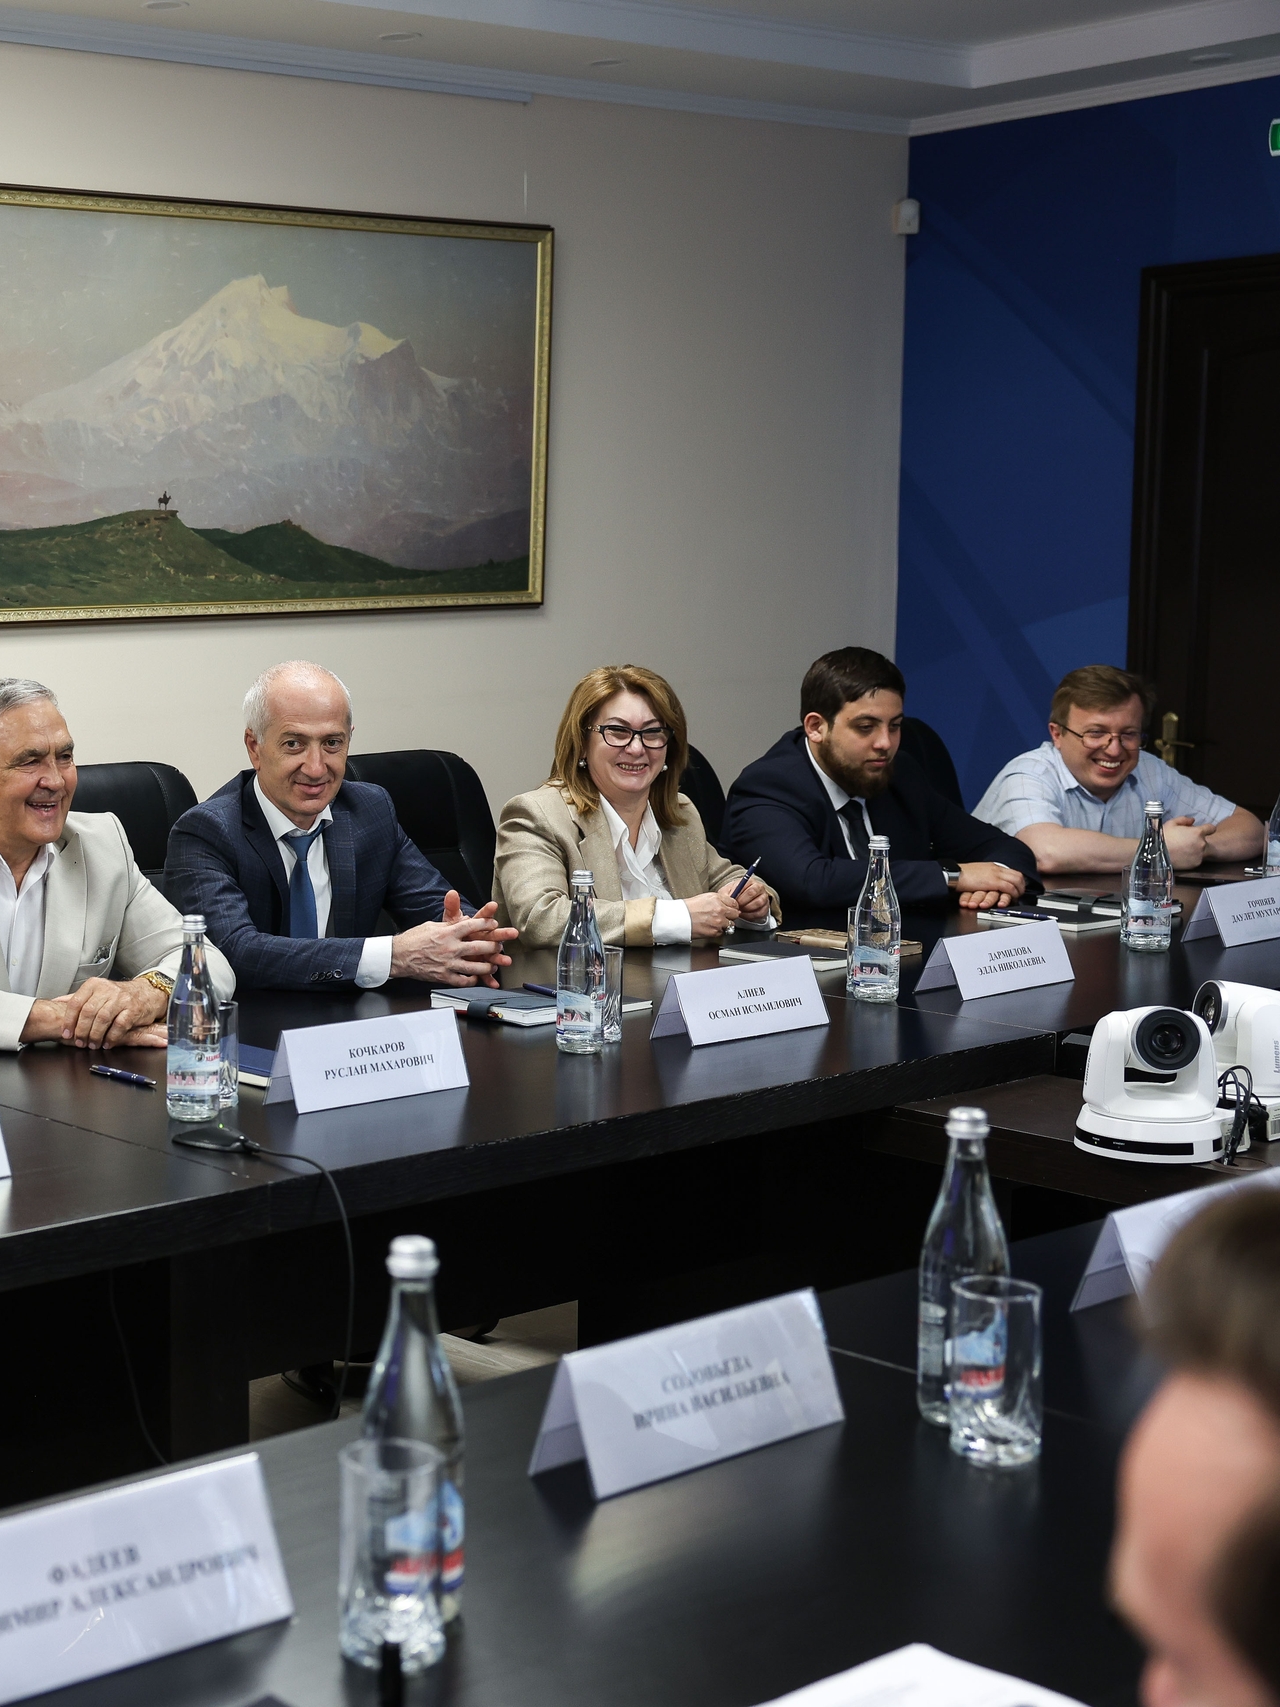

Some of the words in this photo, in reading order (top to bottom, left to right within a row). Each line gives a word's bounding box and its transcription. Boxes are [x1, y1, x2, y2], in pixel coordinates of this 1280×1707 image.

[1247, 897, 1276, 908] ГОЧИЯЕВ
[1232, 911, 1255, 924] ДАУЛЕТ
[988, 946, 1033, 962] ДАРМИЛОВА
[977, 965, 998, 976] ЭЛЛА
[998, 956, 1046, 973] НИКОЛАЕВНА
[737, 986, 766, 1000] АЛИЕВ
[708, 1007, 741, 1021] ОСМАН
[741, 997, 803, 1015] ИСМАИЛОВИЧ
[348, 1041, 406, 1059] КОЧКАРОВ
[324, 1064, 368, 1080] РУСЛАН
[369, 1054, 435, 1074] МАХАРОВИЧ
